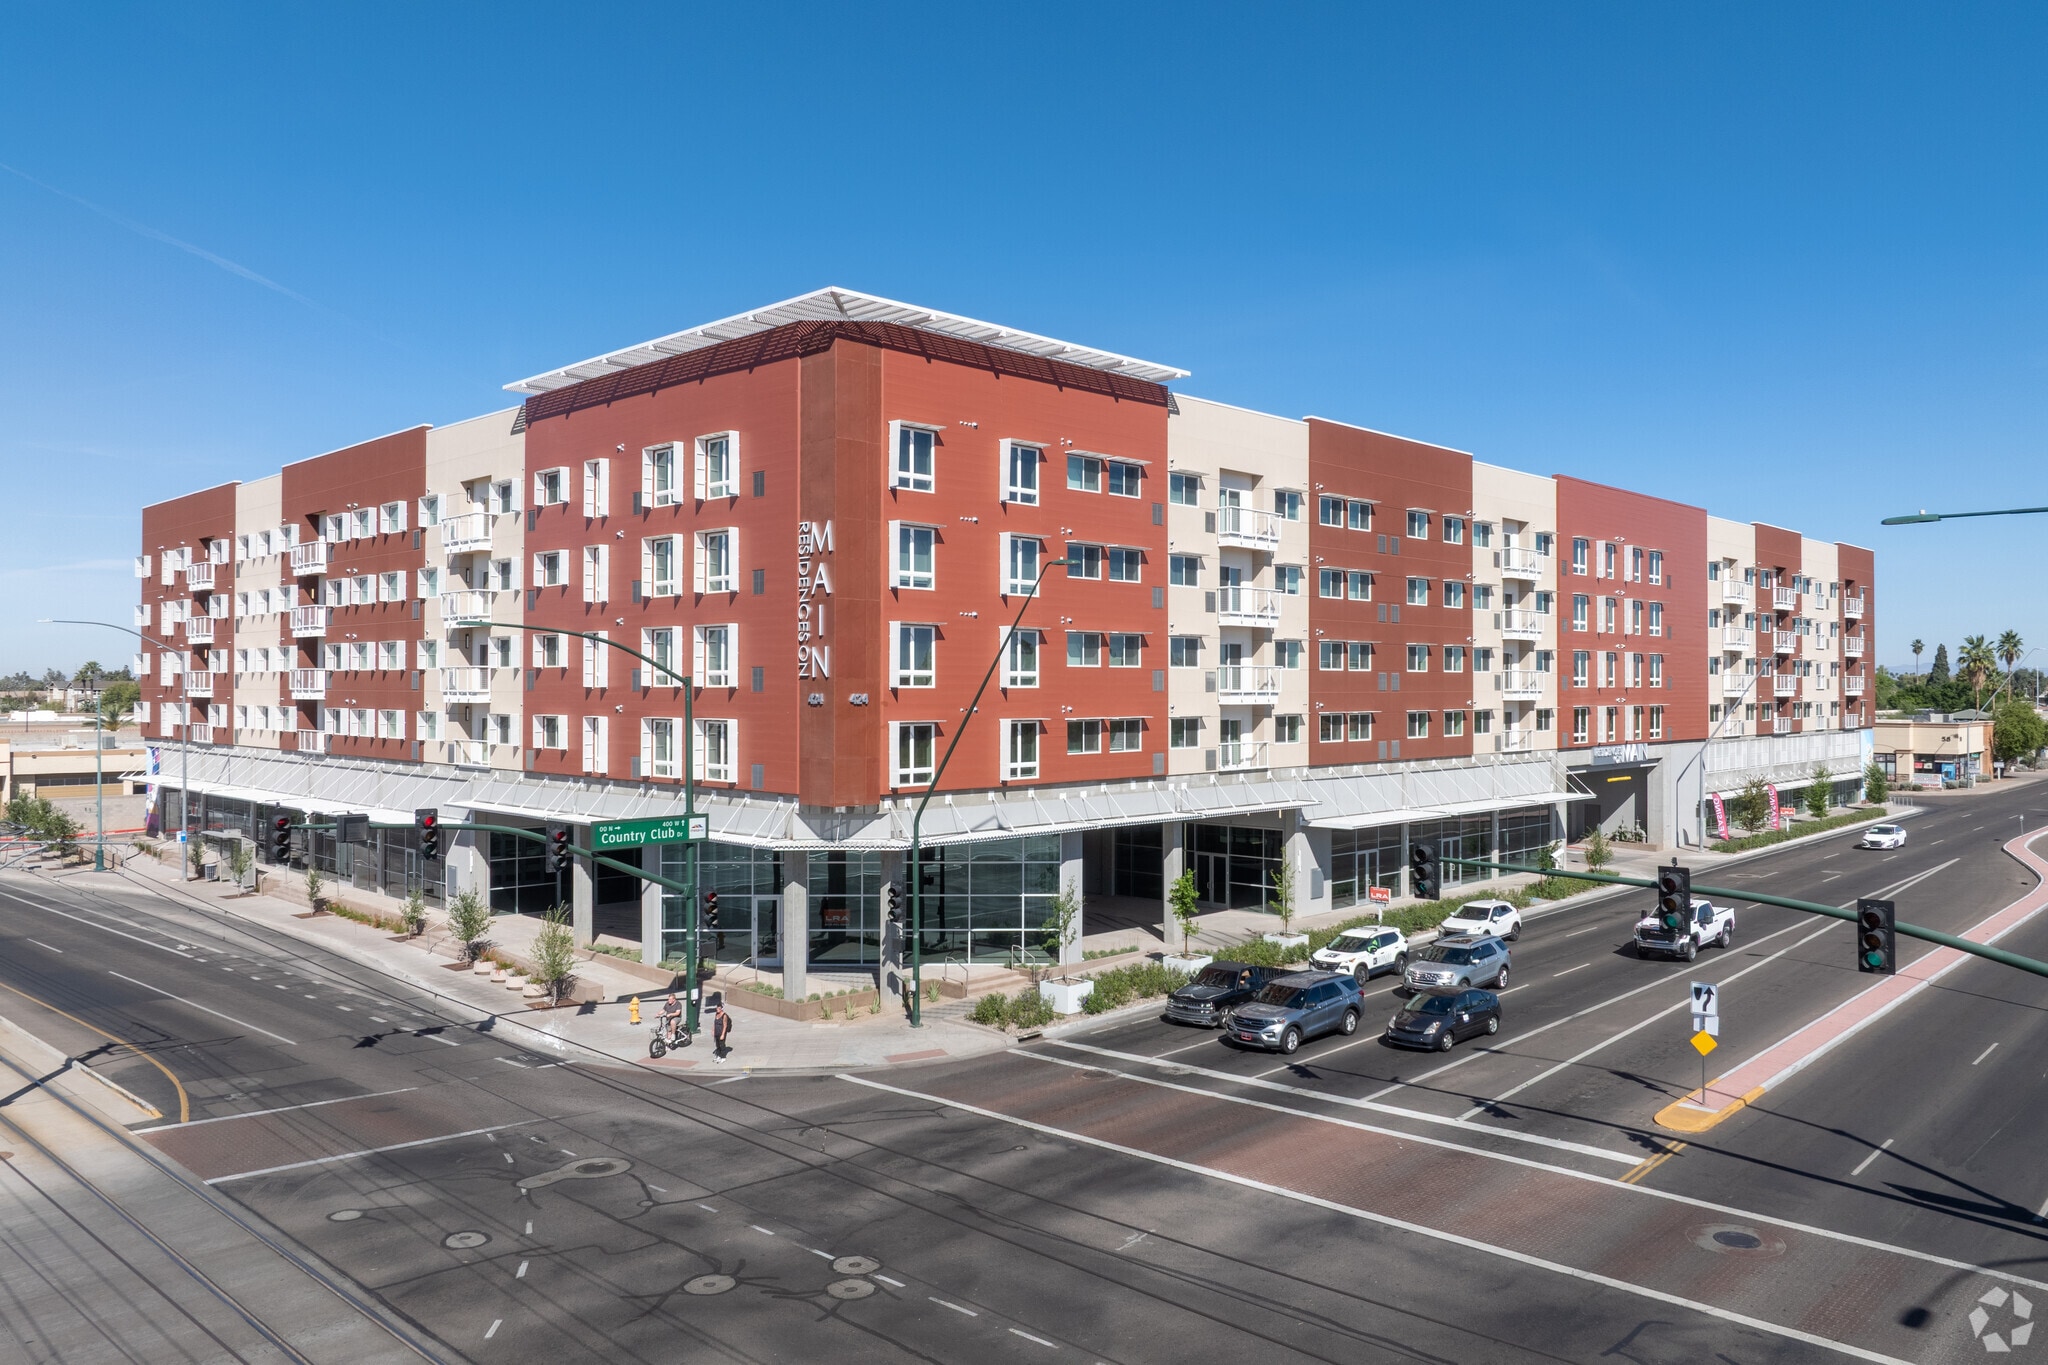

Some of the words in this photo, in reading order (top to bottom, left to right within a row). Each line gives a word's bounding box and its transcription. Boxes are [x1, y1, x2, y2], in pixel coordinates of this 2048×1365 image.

[798, 521, 811, 642] RESIDENCES
[810, 519, 834, 678] MAIN
[798, 645, 811, 677] ON
[601, 830, 646, 844] Country
[650, 827, 675, 840] Club
[1370, 892, 1389, 900] LRA
